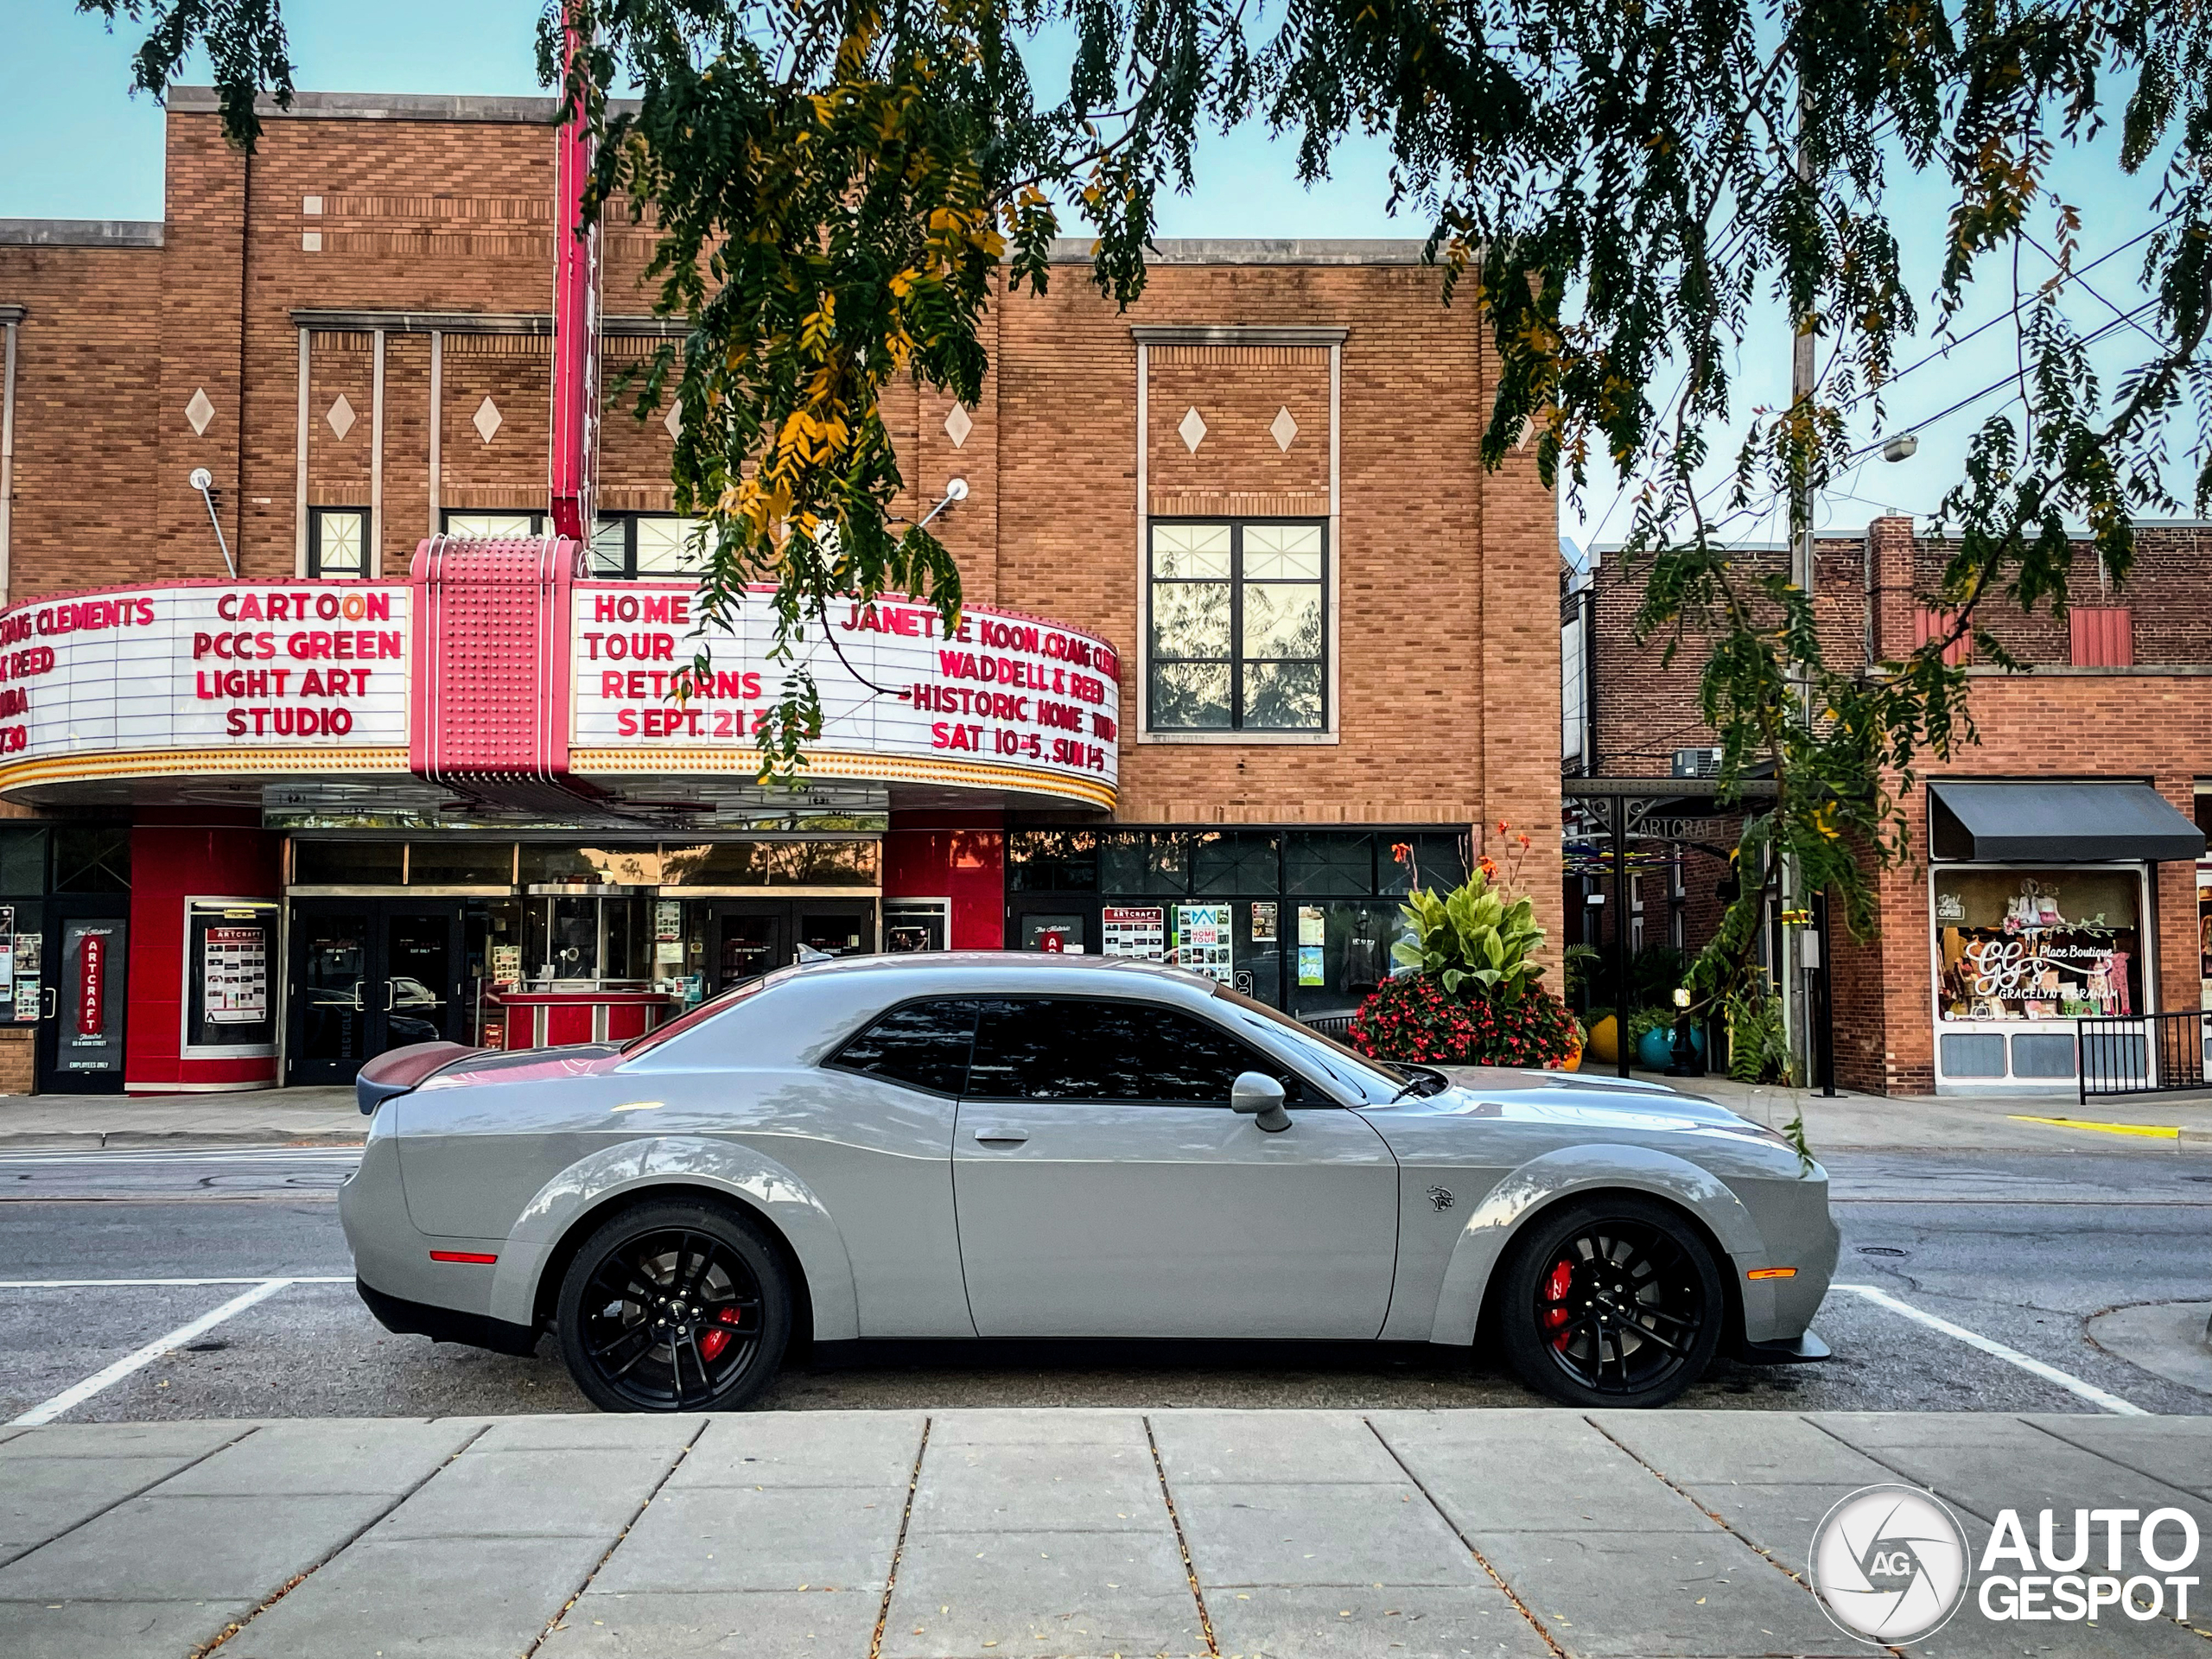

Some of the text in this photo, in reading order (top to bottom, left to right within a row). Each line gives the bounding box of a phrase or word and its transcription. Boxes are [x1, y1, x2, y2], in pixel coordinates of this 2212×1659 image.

[36, 598, 155, 636] CLEMENTS
[218, 593, 390, 621] CARTOON
[595, 594, 690, 624] HOME
[841, 604, 972, 643] JANETE
[194, 631, 401, 660] PCCS GREEN
[584, 632, 674, 661] TOUR
[11, 645, 54, 680] REED
[939, 650, 1104, 705] WADDELL & REED
[197, 669, 371, 699] LIGHT ART
[601, 671, 761, 699] RETURNS
[226, 708, 353, 736] STUDIO
[618, 709, 705, 737] SEPT.
[714, 709, 745, 737] 21
[1038, 699, 1084, 733] HOME
[932, 722, 983, 752] SAT
[1052, 738, 1084, 767] SUN
[1638, 819, 1726, 838] ARTCRAFT
[2039, 944, 2068, 957] Place
[2069, 944, 2114, 962] Boutique
[86, 941, 98, 1030] ARTCRAFT
[1998, 988, 2057, 1000] GRACELYN
[2071, 988, 2119, 1000] GRAHAM
[342, 1011, 352, 1058] RECYCLE
